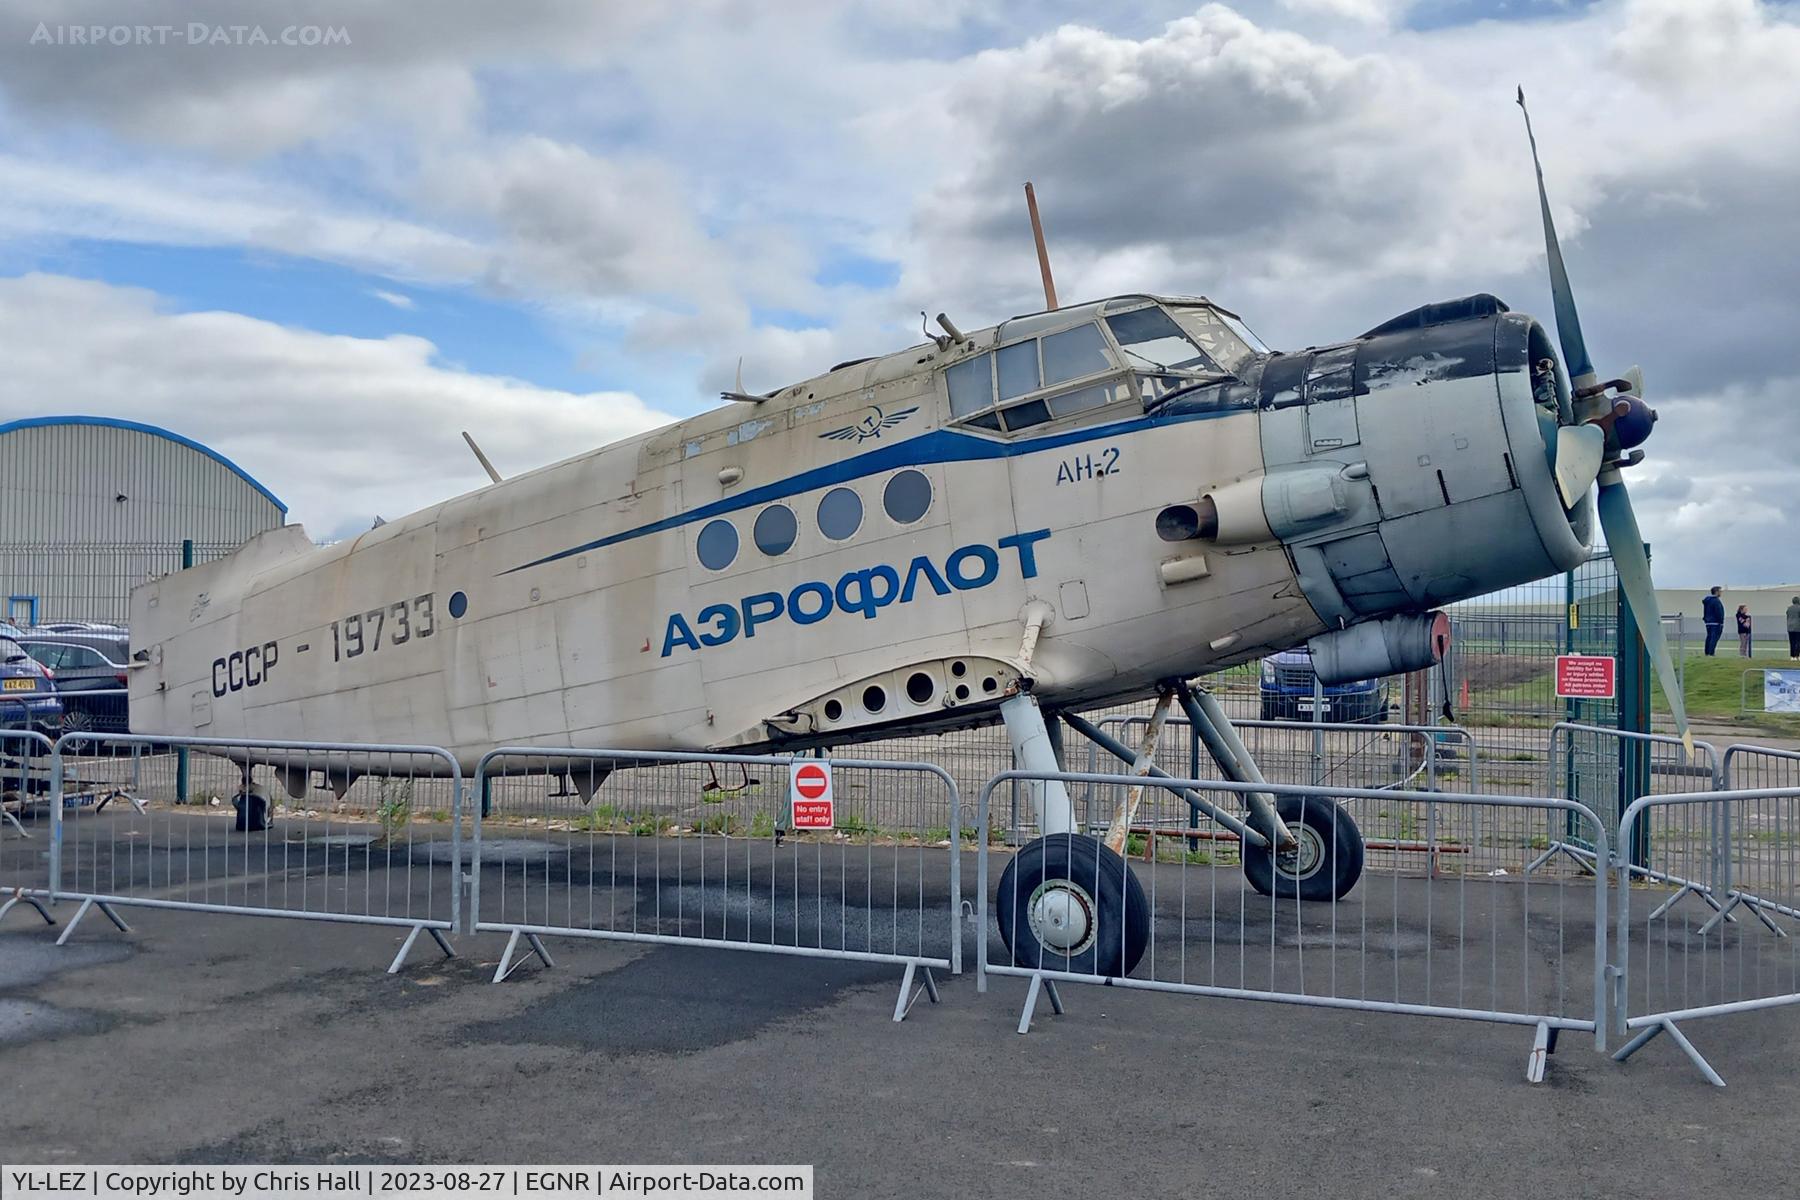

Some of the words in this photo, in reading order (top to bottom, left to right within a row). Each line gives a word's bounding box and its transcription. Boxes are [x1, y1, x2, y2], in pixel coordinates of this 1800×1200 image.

[661, 528, 1052, 658] АЭРОФЛОТ
[212, 641, 278, 698] СССР
[331, 592, 437, 662] 19733
[796, 815, 813, 823] staff
[814, 816, 830, 825] only
[797, 805, 807, 813] No
[809, 805, 828, 815] entry
